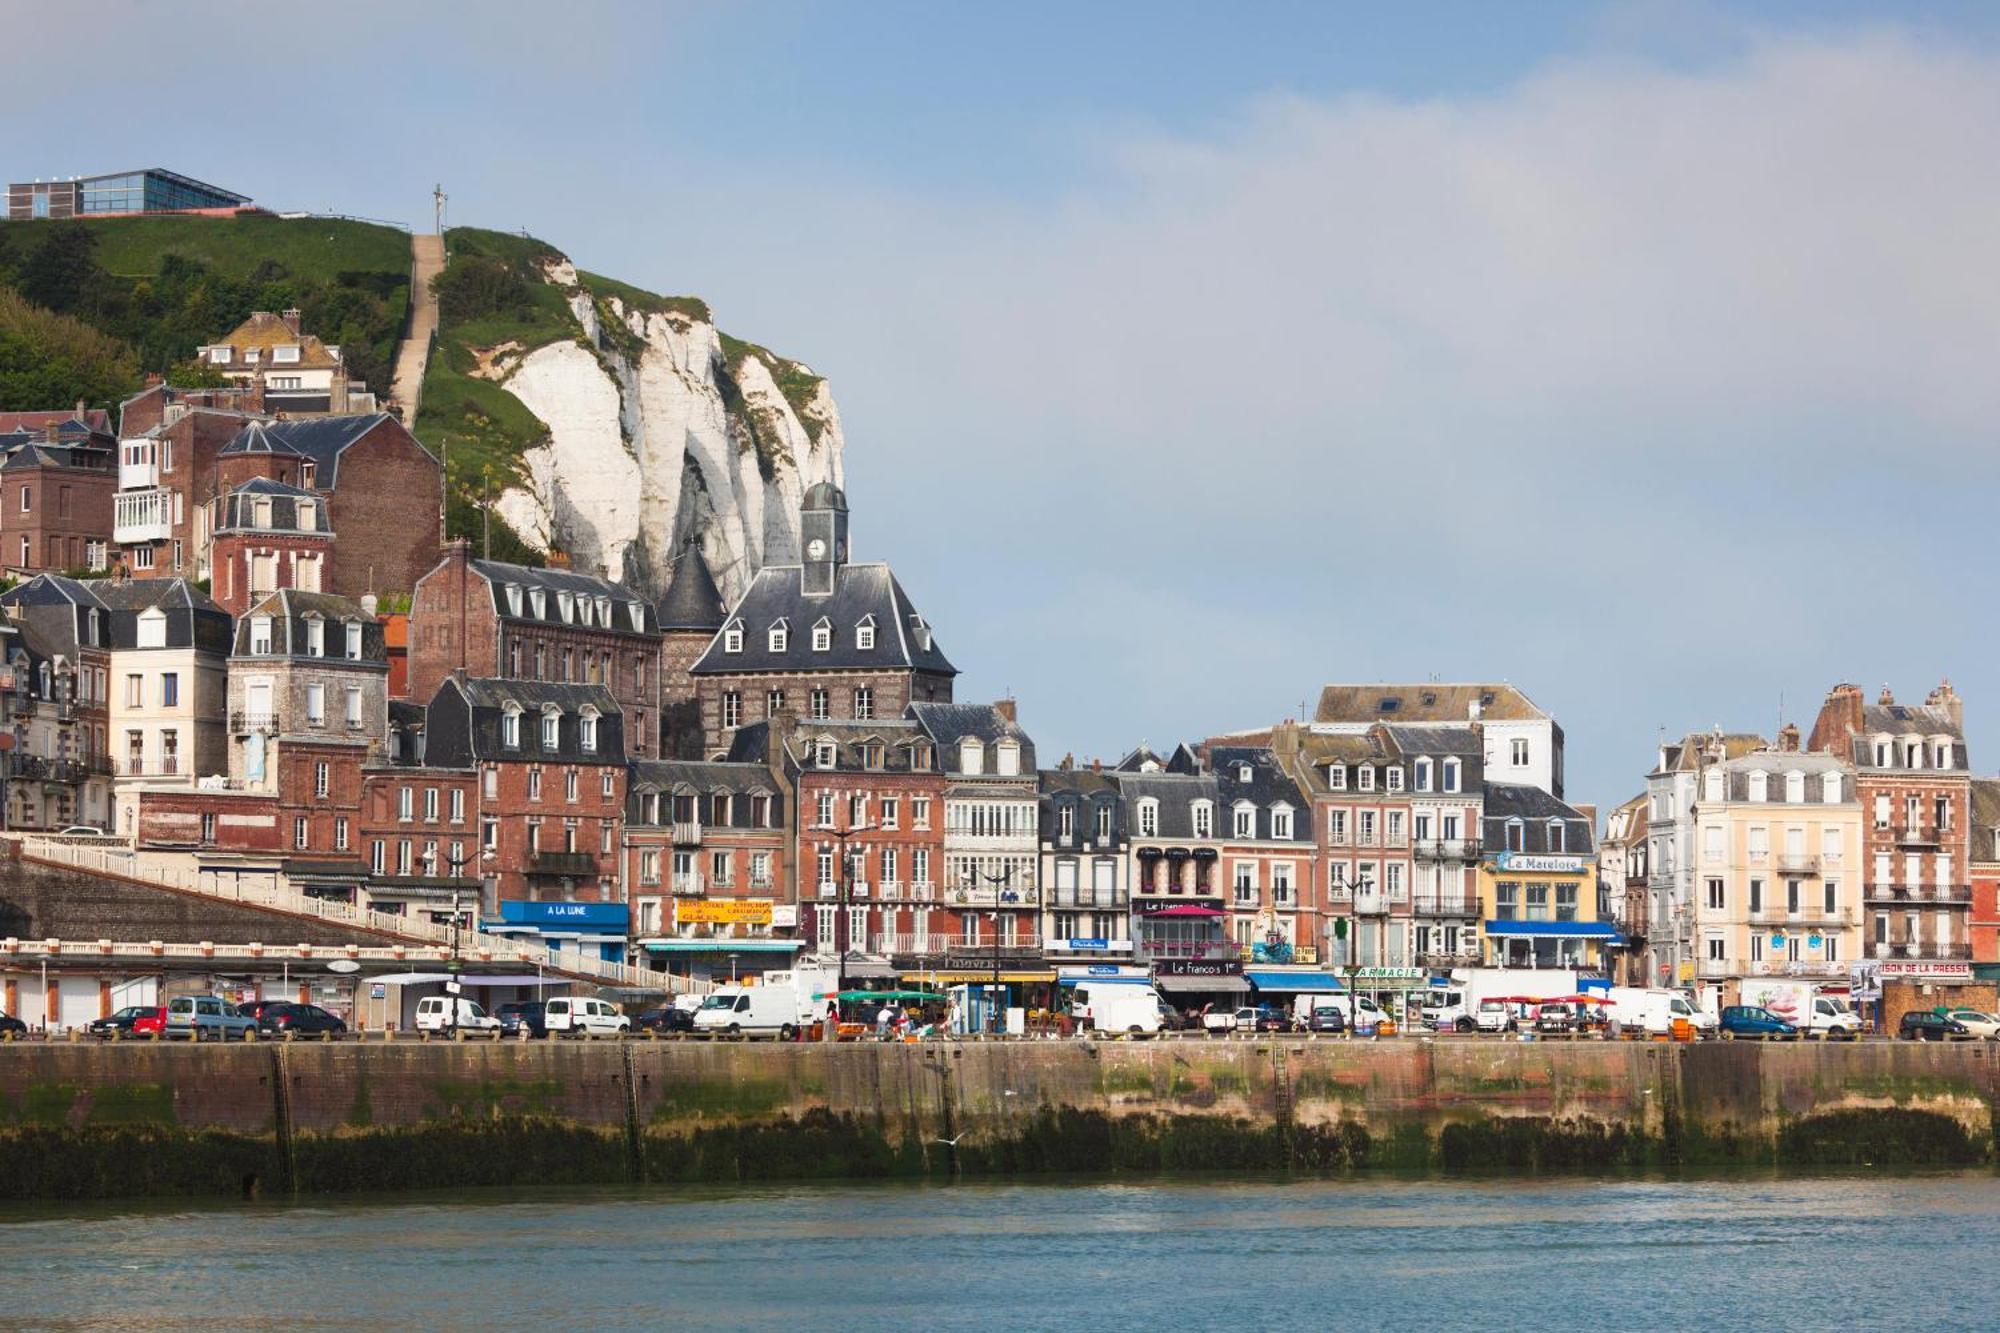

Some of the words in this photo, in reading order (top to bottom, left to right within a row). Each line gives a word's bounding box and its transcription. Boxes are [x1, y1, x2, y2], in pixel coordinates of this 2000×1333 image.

[1507, 858, 1522, 869] La
[1526, 858, 1577, 869] Matelote
[548, 906, 554, 915] A
[555, 906, 565, 915] LA
[567, 906, 586, 915] LUNE
[1146, 902, 1158, 910] Le
[1172, 962, 1184, 974] Le
[1342, 968, 1417, 977] PARMACIE
[1906, 964, 1917, 973] DE
[1920, 964, 1930, 973] LA
[1933, 964, 1967, 973] PRESSE
